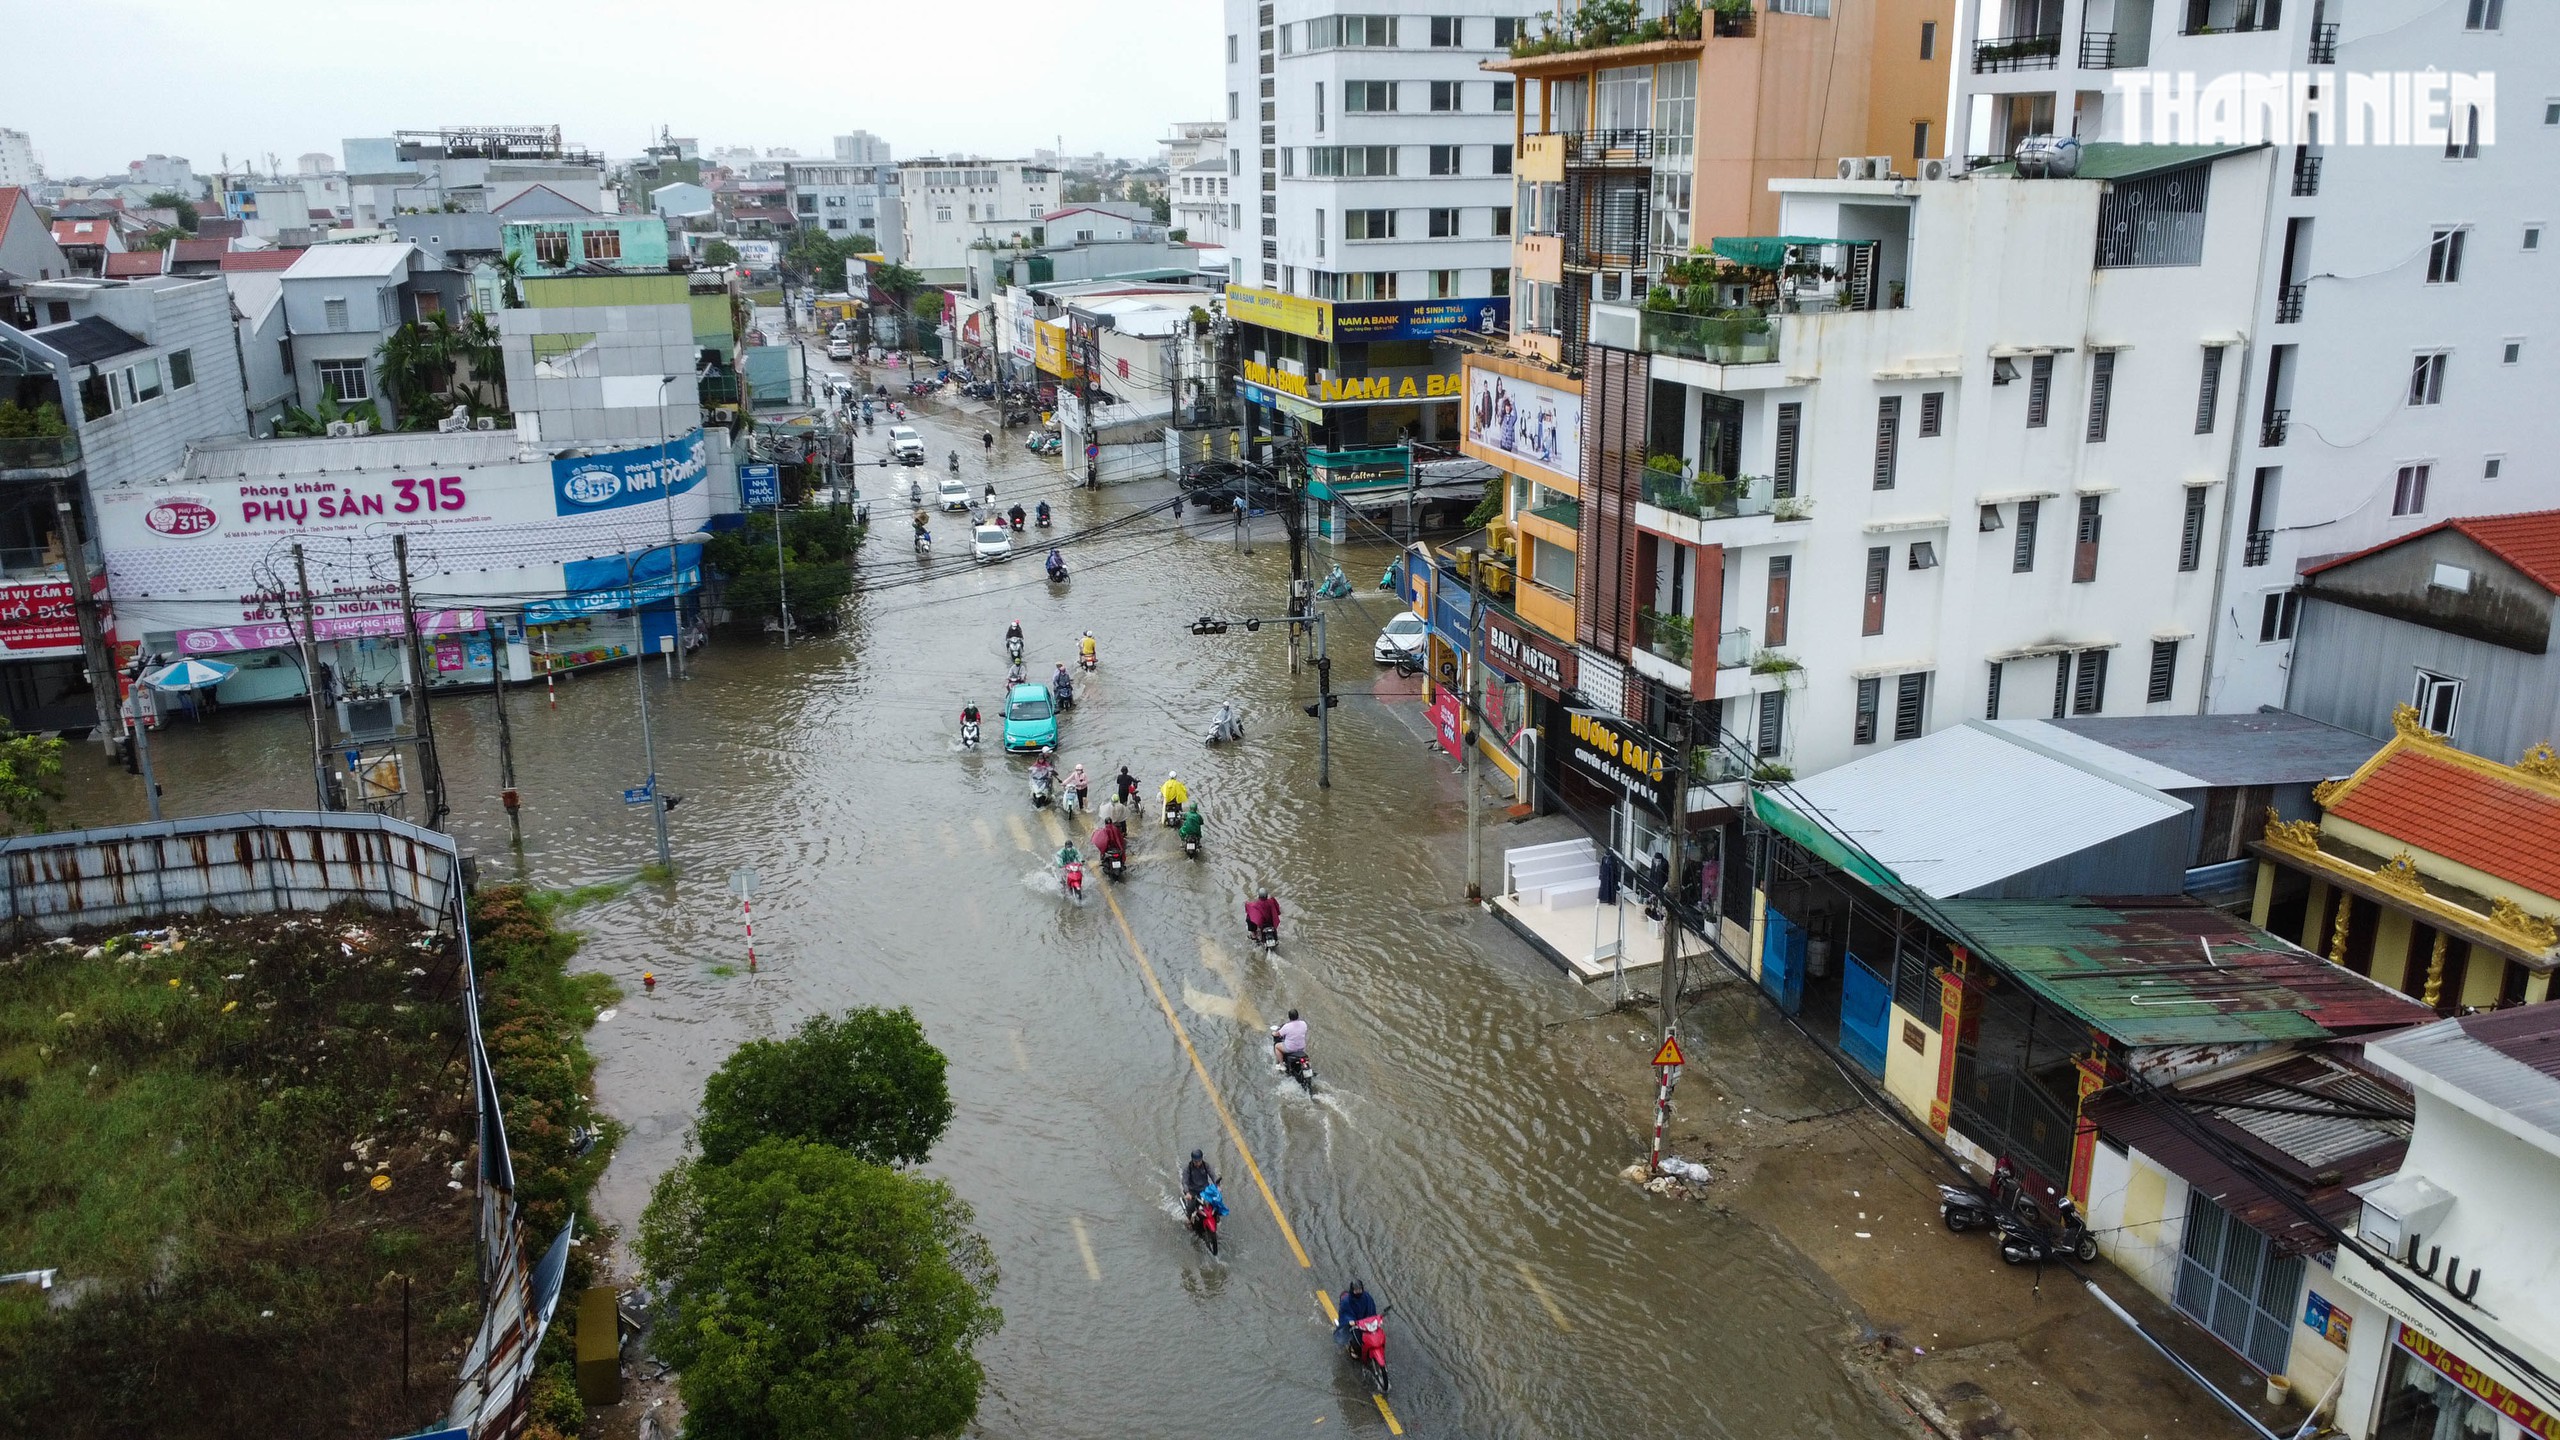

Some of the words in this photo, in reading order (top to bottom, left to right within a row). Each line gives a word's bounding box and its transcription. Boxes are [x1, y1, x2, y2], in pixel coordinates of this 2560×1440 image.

[1426, 306, 1444, 314] SINH
[1338, 317, 1362, 326] NAM
[1363, 317, 1371, 325] A
[1372, 315, 1399, 324] BANK
[1243, 359, 1268, 386] NAM
[1269, 367, 1277, 389] A
[1278, 367, 1308, 398] BANK
[1320, 376, 1391, 401] NAM
[1397, 376, 1418, 398] A
[1426, 373, 1462, 396] BA
[240, 484, 289, 497] Phòng
[294, 481, 336, 494] khám
[591, 481, 616, 497] 315
[626, 471, 657, 493] NHI
[749, 485, 774, 496] THUỐC
[752, 479, 769, 487] NHÀ
[242, 498, 308, 525] PHỤ
[318, 488, 384, 518] SẢN
[391, 476, 467, 513] 315
[178, 514, 210, 531] 315
[12, 589, 30, 602] VỤ
[583, 593, 608, 606] TOP
[1491, 626, 1519, 659] BALY
[1522, 645, 1560, 682] HOTEL
[1570, 712, 1619, 757] HƯƠNG
[1574, 748, 1602, 771] CHUYÊN
[2379, 1297, 2411, 1321] LOCATION
[2411, 1317, 2424, 1329] FOR
[2424, 1325, 2438, 1338] YOU
